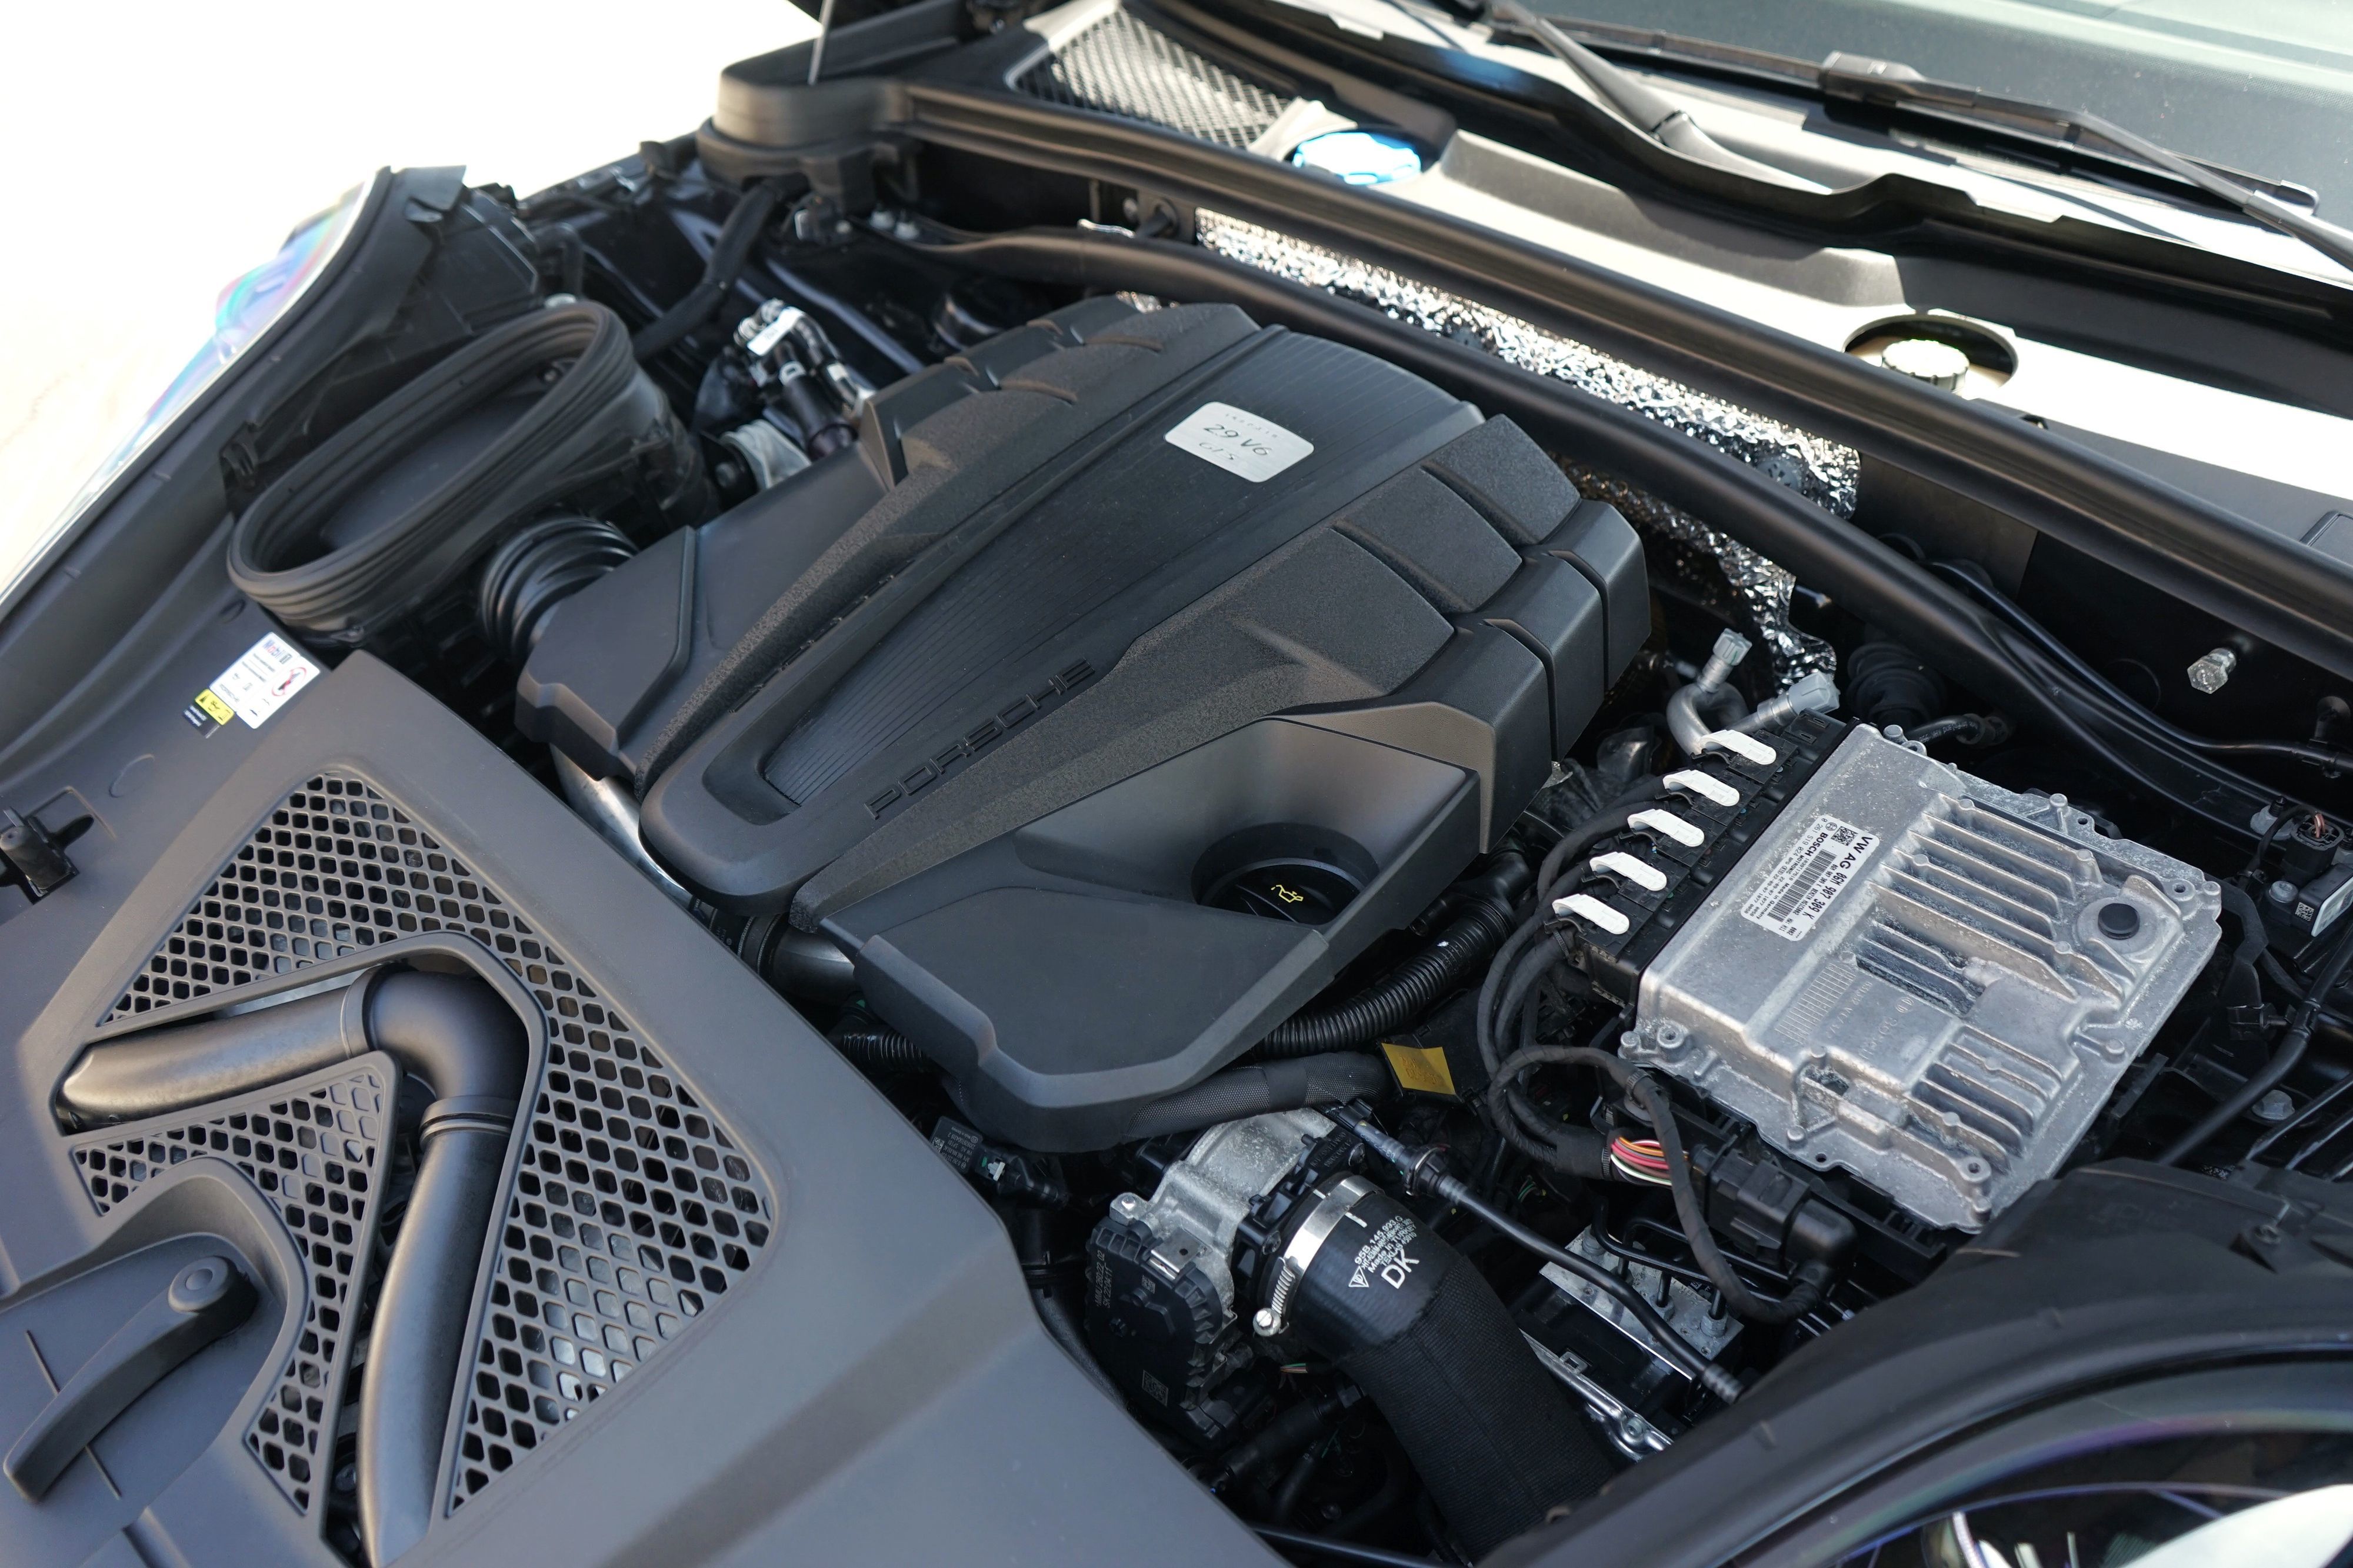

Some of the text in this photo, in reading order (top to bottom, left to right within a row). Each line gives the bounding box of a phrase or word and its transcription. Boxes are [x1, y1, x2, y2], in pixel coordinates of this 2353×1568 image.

[1240, 438, 1274, 456] V6
[864, 658, 1095, 820] PORSCHE
[1811, 823, 1822, 833] 261
[1804, 832, 1828, 856] BOSCH
[1851, 835, 1872, 853] VW
[1785, 854, 1805, 875] MOTRONIC
[1838, 852, 1858, 870] AG
[1829, 871, 1848, 886] 06M
[1777, 882, 1789, 895] Made
[1818, 885, 1837, 899] 907
[1755, 899, 1775, 920] Germany
[1807, 898, 1825, 913] 309
[1368, 1250, 1387, 1273] Made
[1391, 1224, 1417, 1243] TURKEY
[1381, 1249, 1420, 1289] DK
